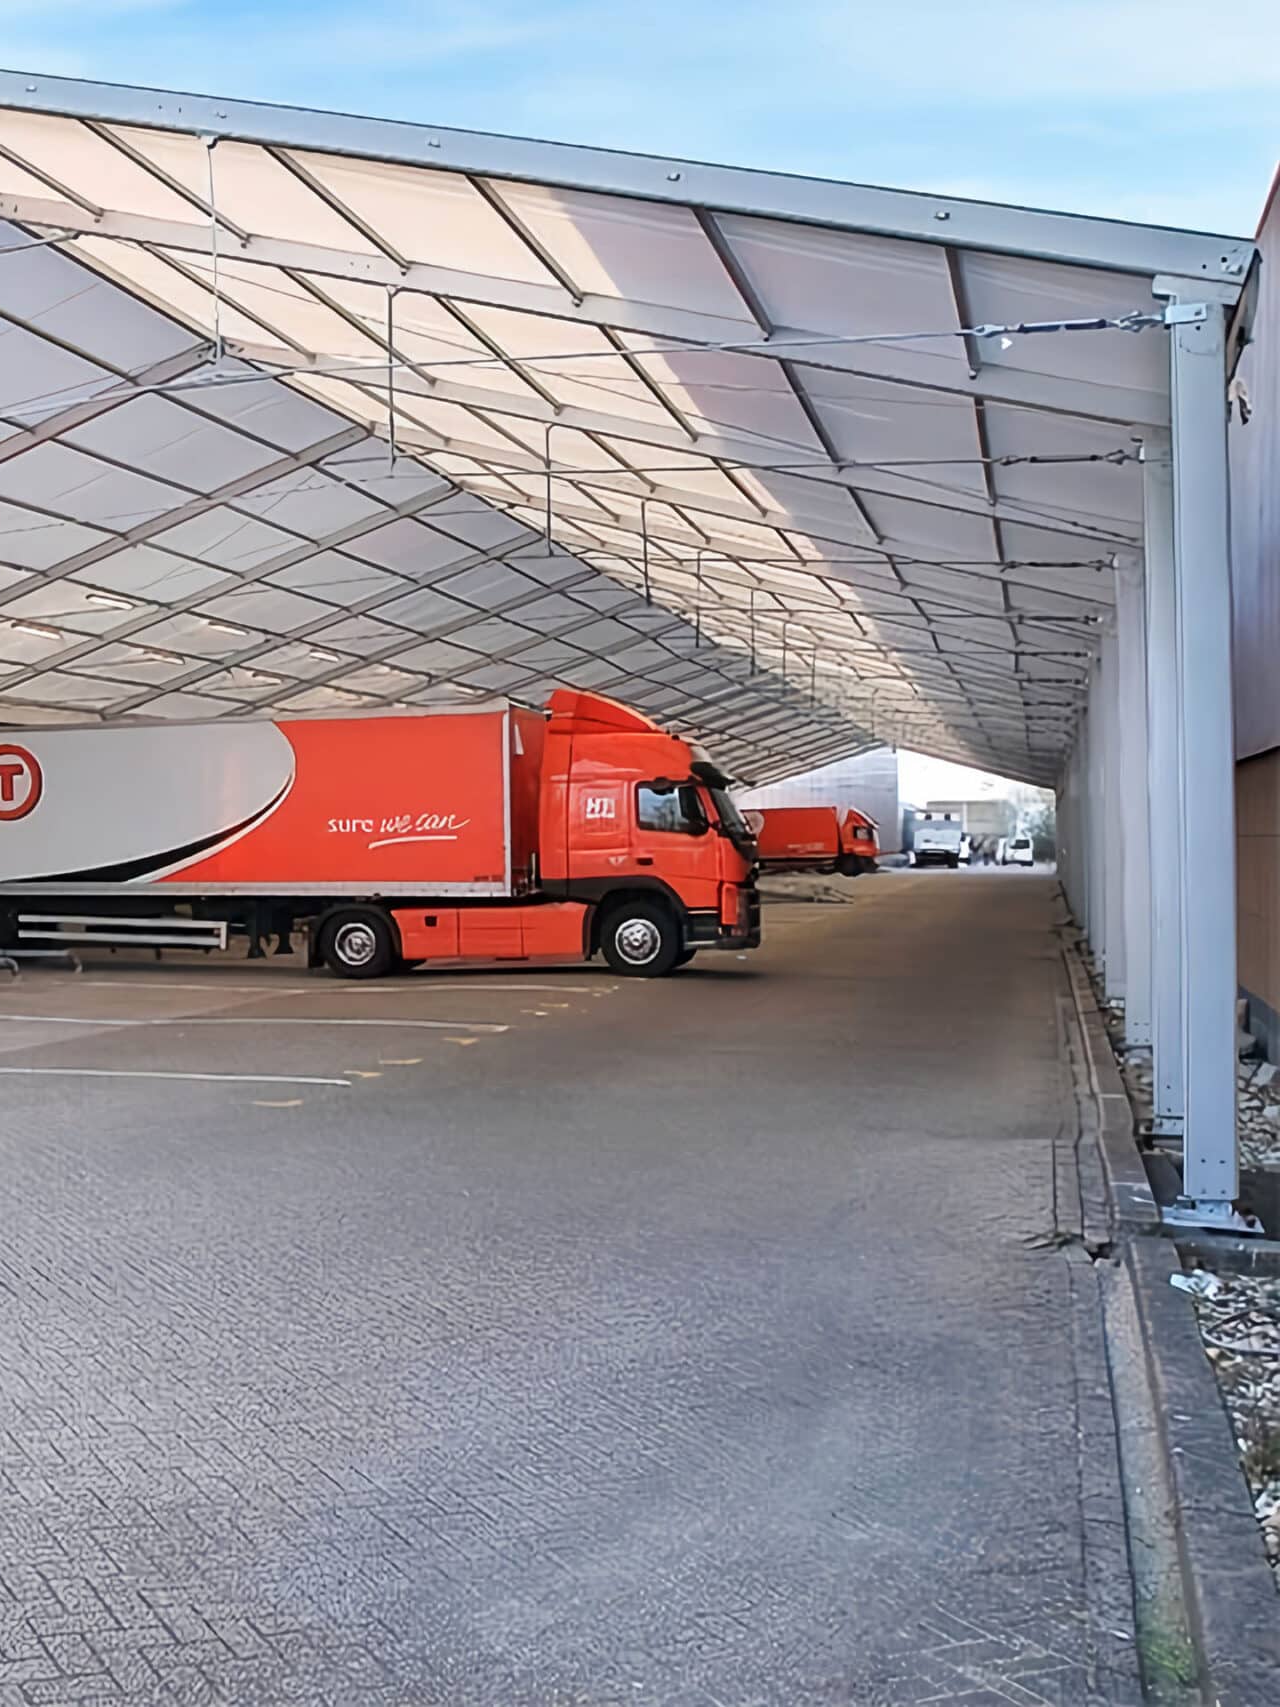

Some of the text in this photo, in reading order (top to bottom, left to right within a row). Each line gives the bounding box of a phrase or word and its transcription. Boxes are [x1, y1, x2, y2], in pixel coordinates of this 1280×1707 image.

[327, 813, 471, 833] sure we can
